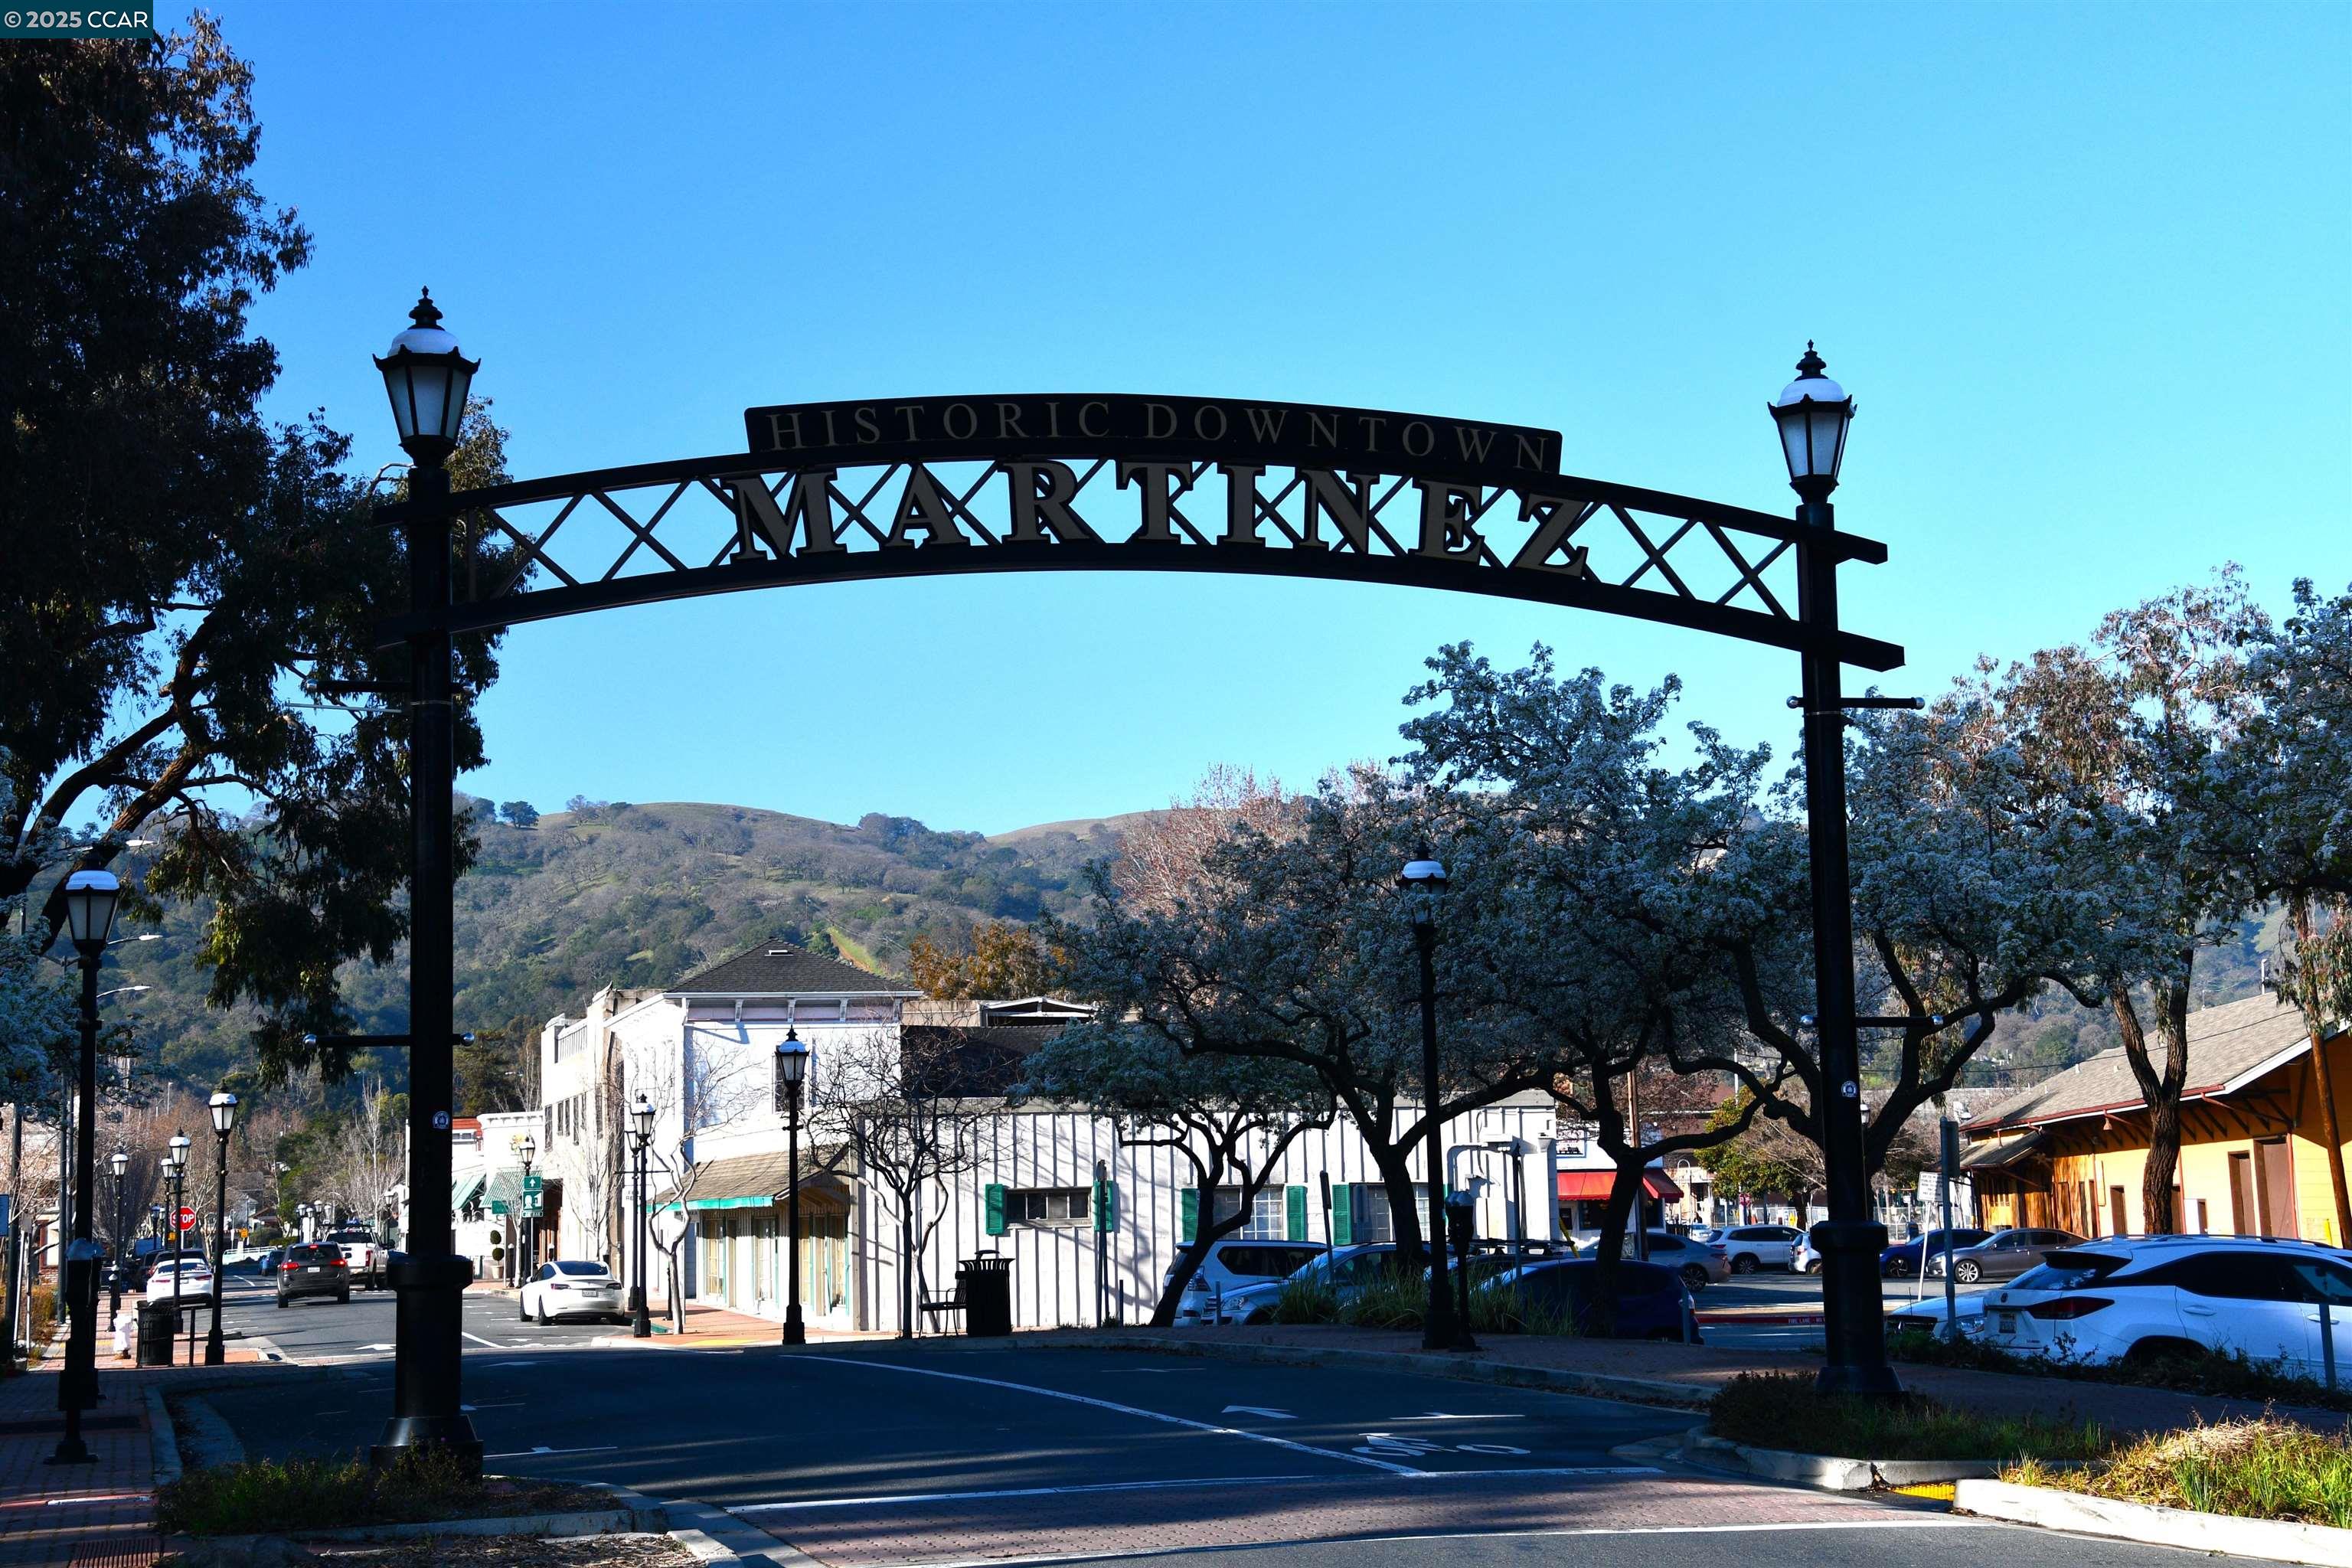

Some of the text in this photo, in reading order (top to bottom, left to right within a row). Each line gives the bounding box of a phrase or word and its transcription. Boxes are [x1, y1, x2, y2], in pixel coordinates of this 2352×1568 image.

[769, 400, 1550, 472] HISTORIC DOWNTOWN
[730, 460, 1589, 578] MARTINEZ
